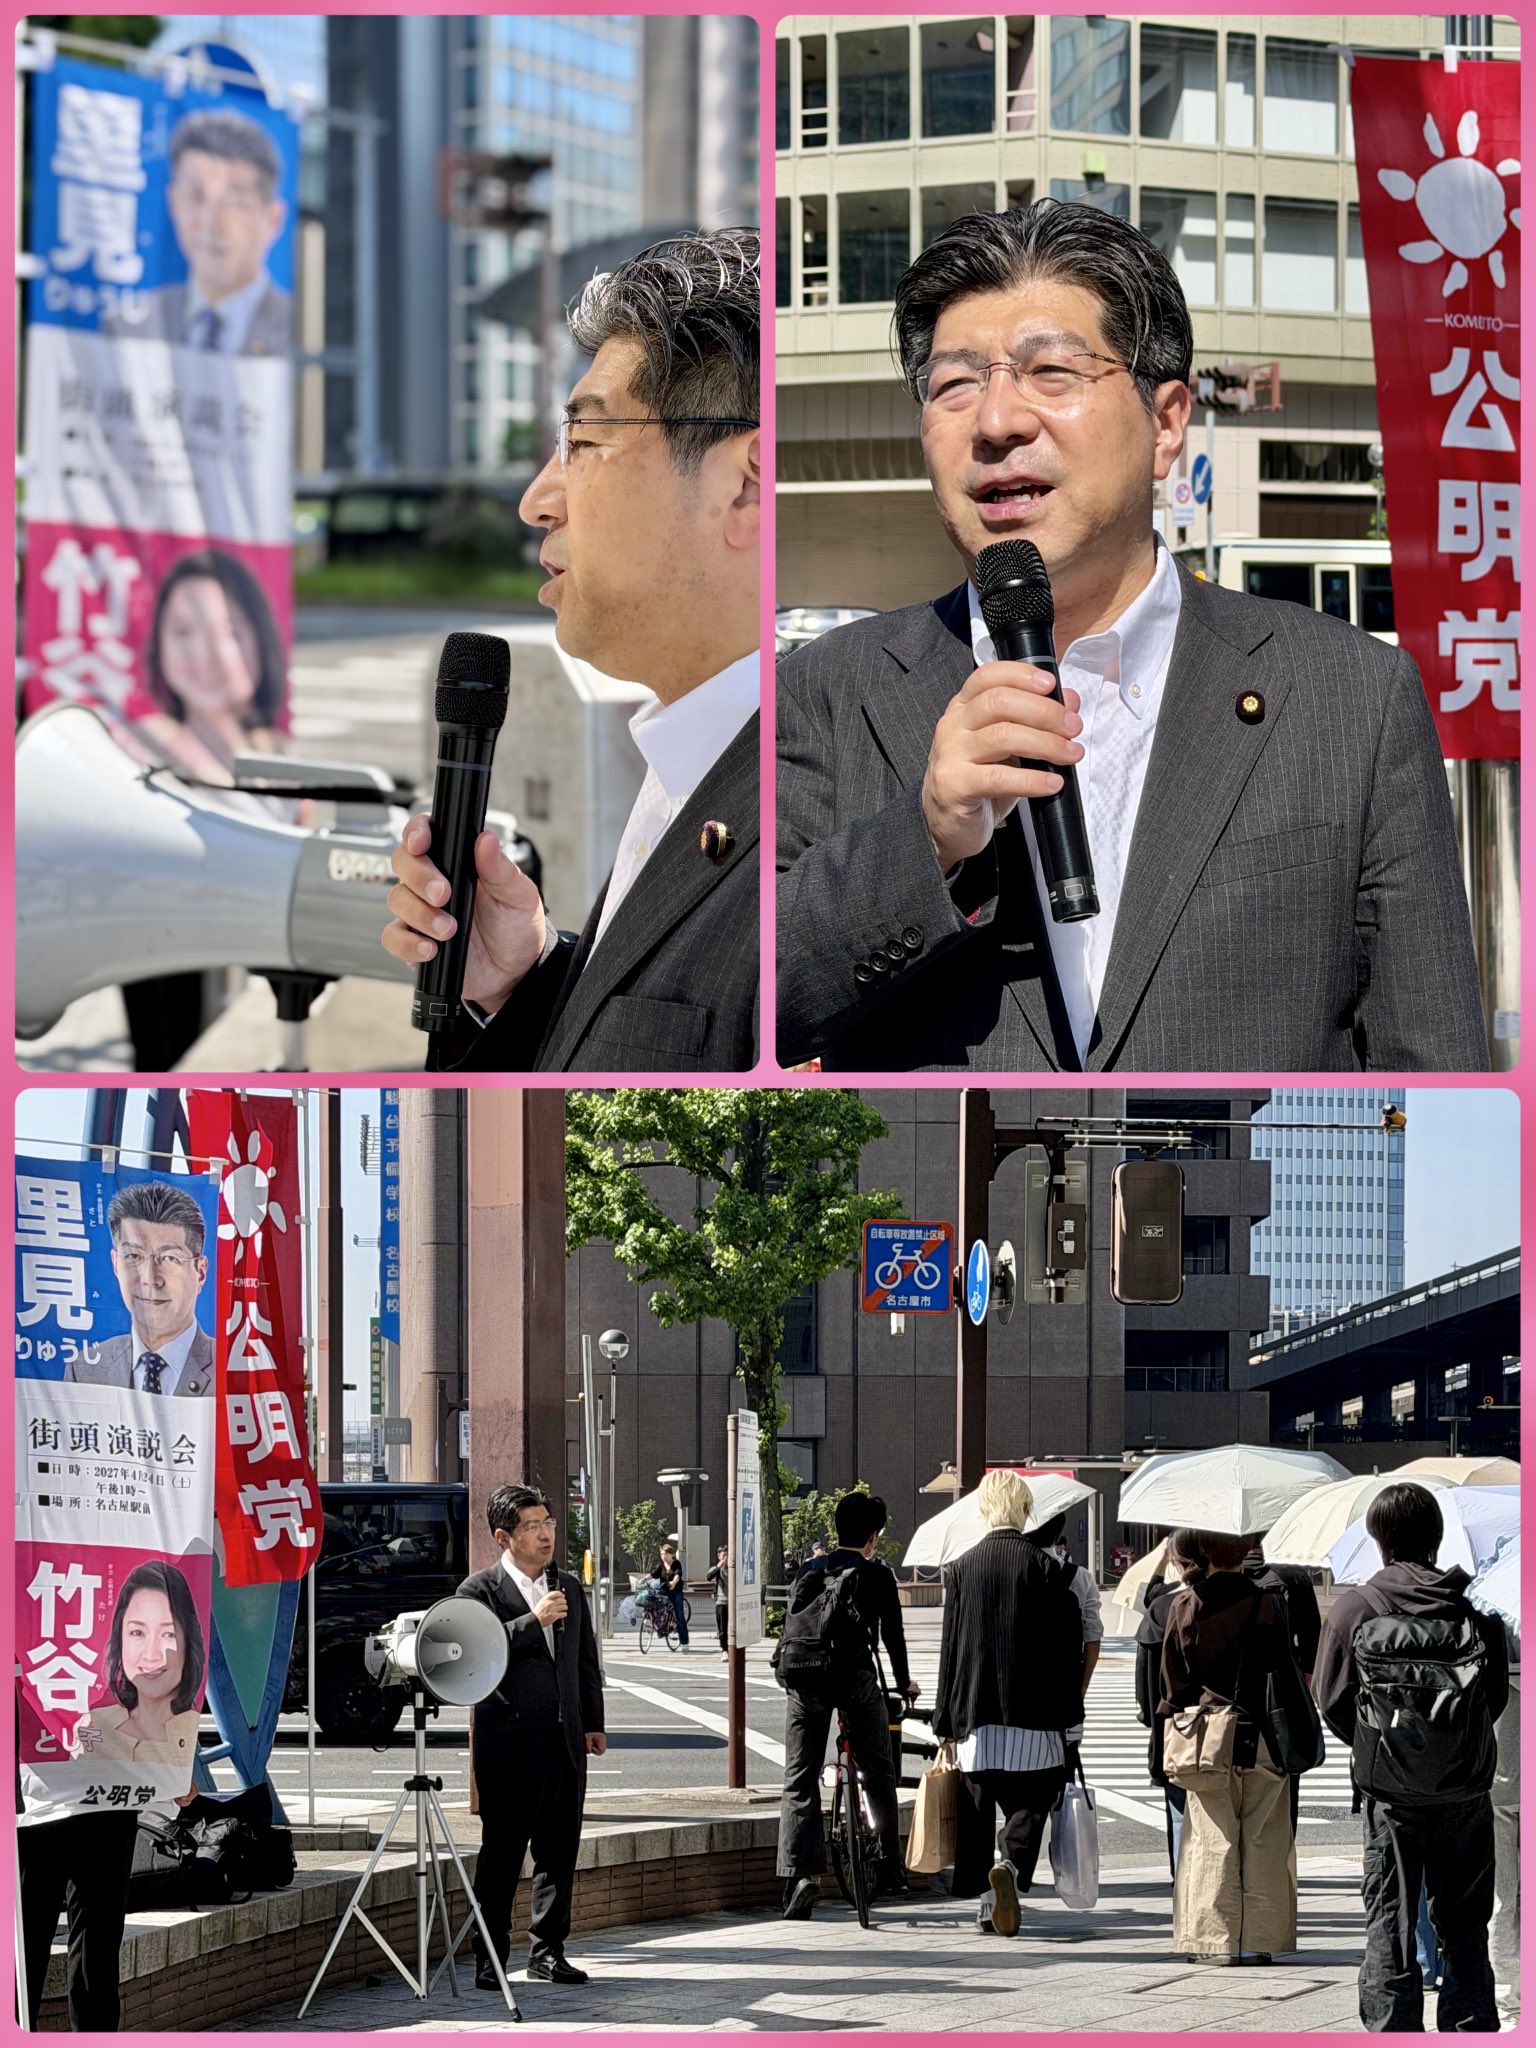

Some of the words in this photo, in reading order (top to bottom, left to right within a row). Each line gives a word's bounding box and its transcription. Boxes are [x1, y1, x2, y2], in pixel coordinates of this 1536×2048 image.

[1429, 346, 1520, 713] 公明党
[15, 1174, 94, 1332] 里見
[870, 1227, 946, 1241] 自転車等放置禁止区域
[886, 1294, 932, 1307] 名古屋市
[15, 1333, 101, 1365] りゅうじ
[28, 1417, 198, 1466] 街頭演説会
[225, 1300, 315, 1551] 公明党
[26, 1560, 103, 1713] 竹谷
[35, 1713, 103, 1752] とし子
[79, 1784, 157, 1807] 公明党
